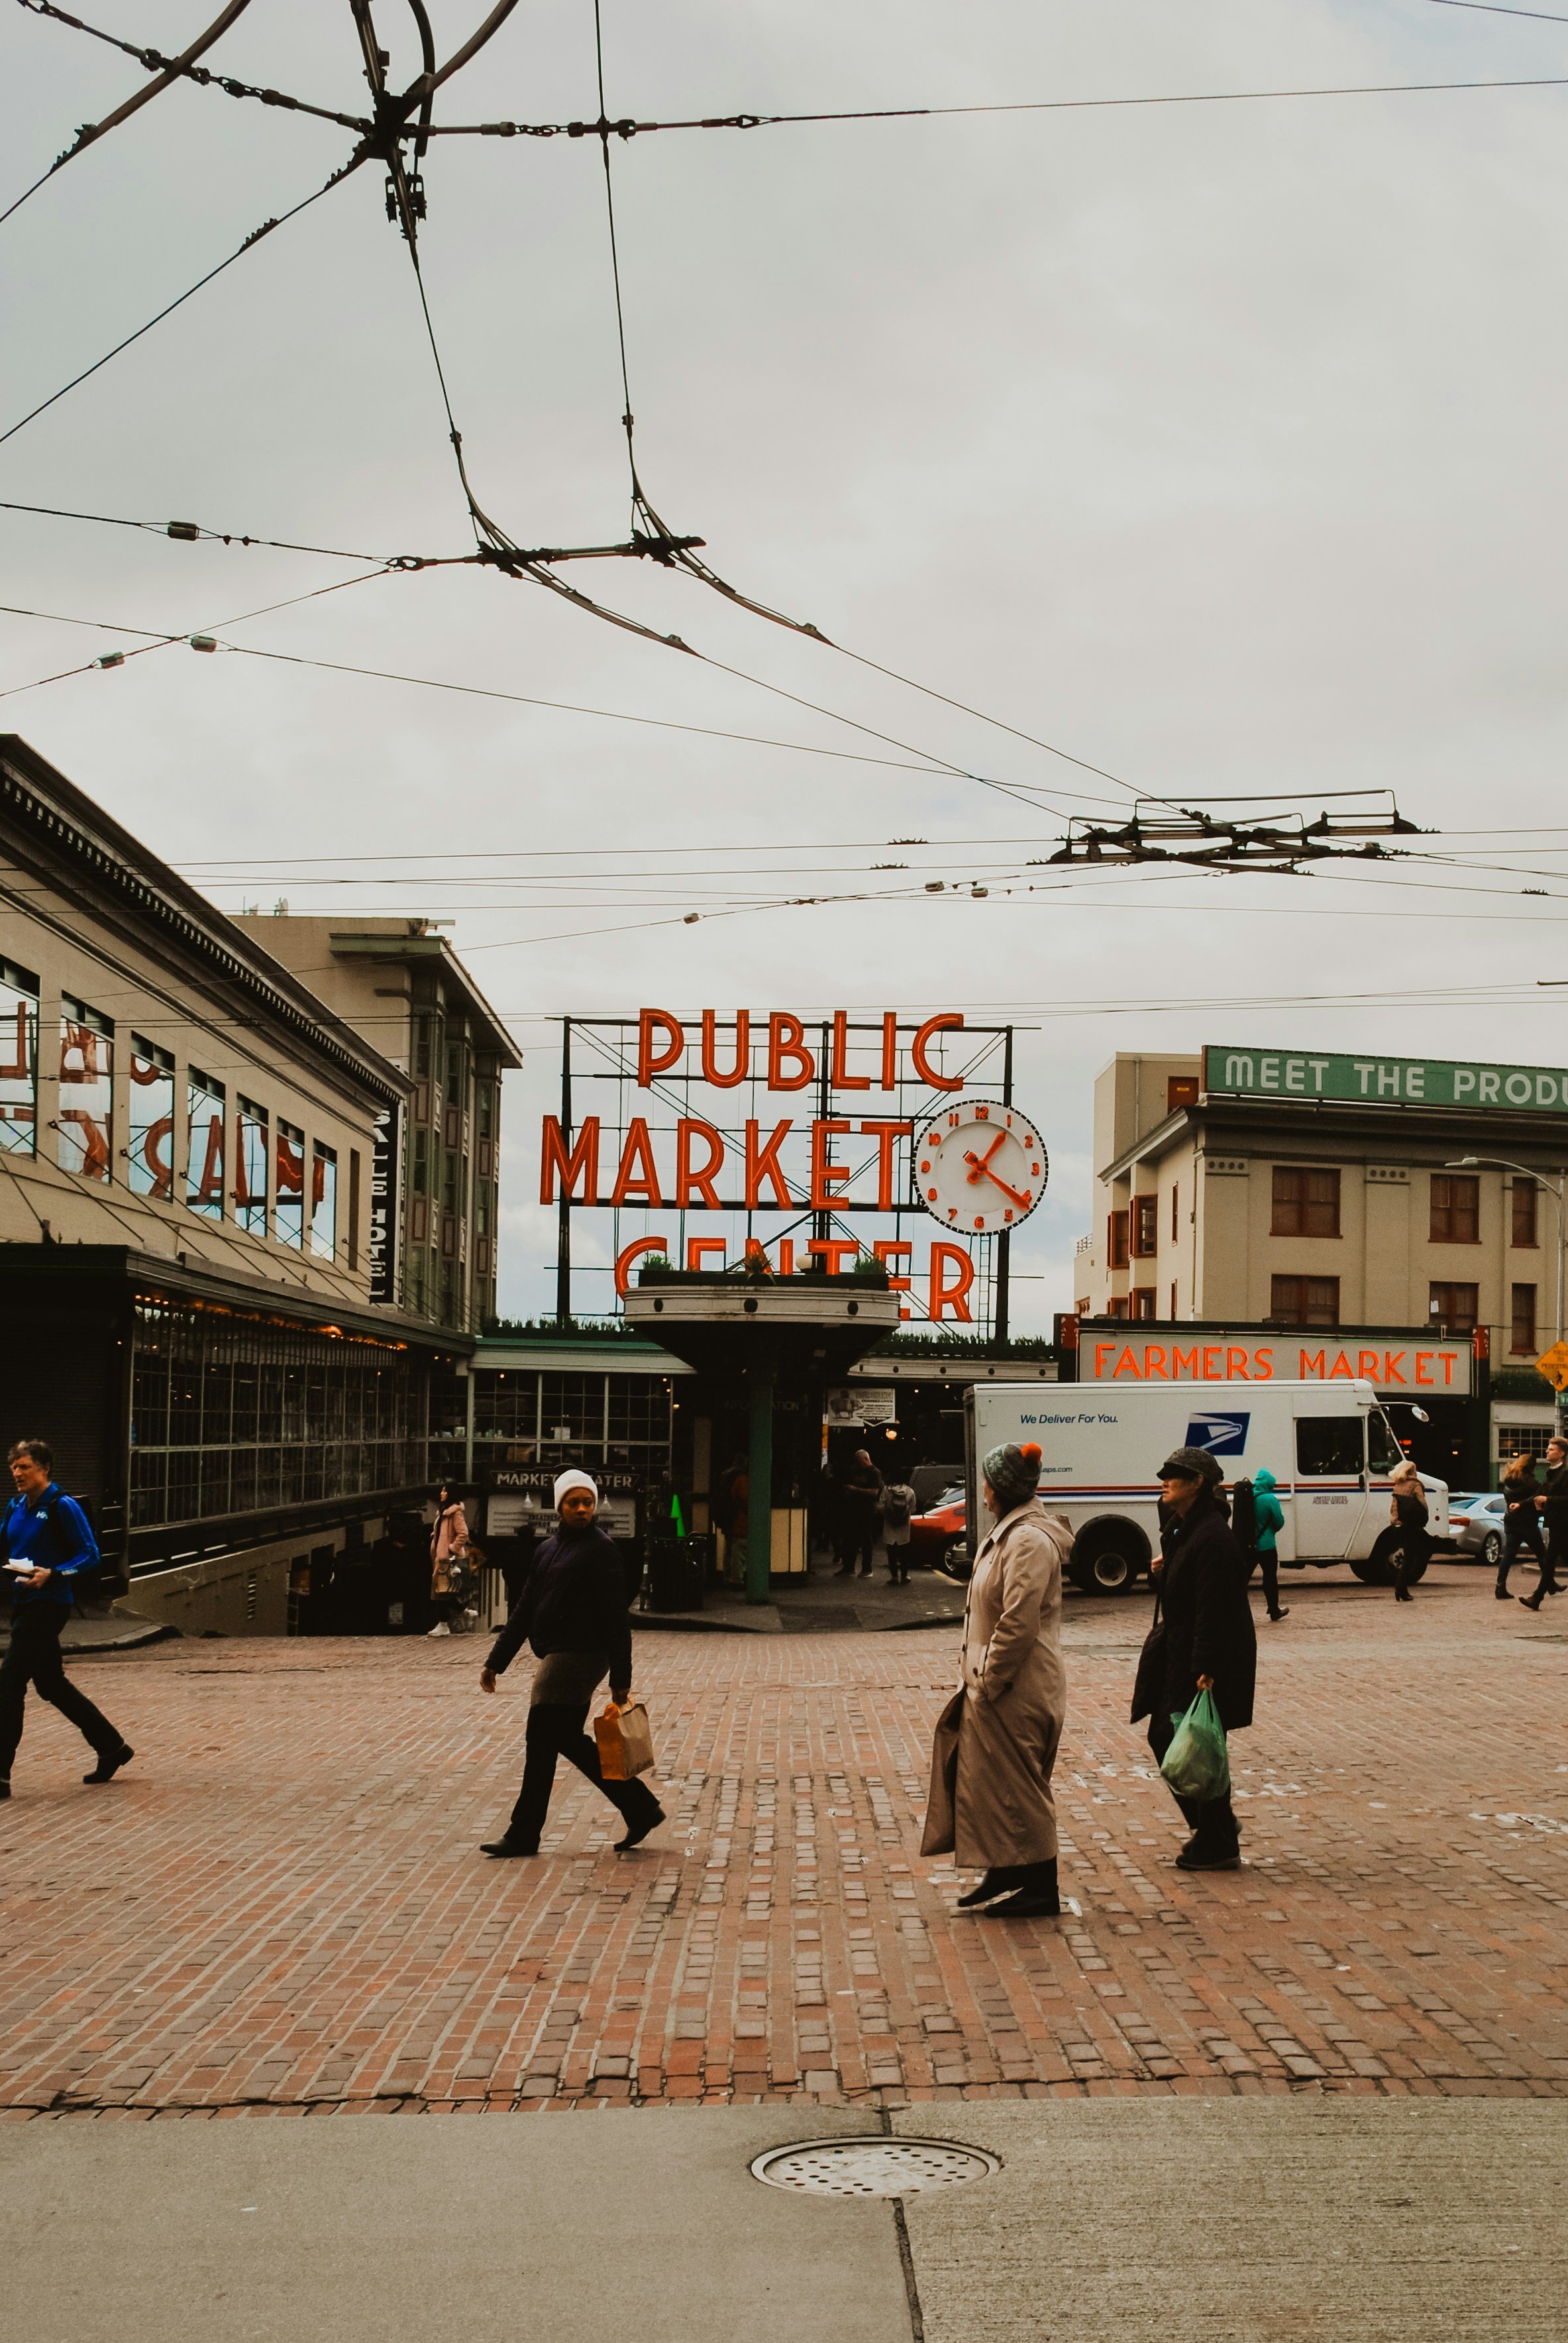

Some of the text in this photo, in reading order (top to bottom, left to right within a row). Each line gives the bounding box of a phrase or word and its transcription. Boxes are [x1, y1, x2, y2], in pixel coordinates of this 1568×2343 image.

[638, 1008, 964, 1092] PUBLIC
[1226, 1055, 1329, 1092] MEET
[1353, 1063, 1425, 1098] THE
[975, 1106, 989, 1120] 12
[949, 1113, 959, 1127] 11
[1007, 1115, 1012, 1128] 1
[929, 1133, 941, 1146] 10
[1025, 1135, 1033, 1148] 2
[540, 1115, 914, 1211] MARKET
[921, 1160, 931, 1173] 9
[1031, 1162, 1039, 1176] 3
[927, 1188, 937, 1201] 8
[948, 1208, 957, 1221] 7
[1004, 1209, 1013, 1222] 5
[974, 1216, 984, 1228] 6
[1095, 1344, 1458, 1384] FARMERS MARKET
[1020, 1413, 1118, 1424] We Deliver For You.
[497, 1473, 558, 1486] MARKET
